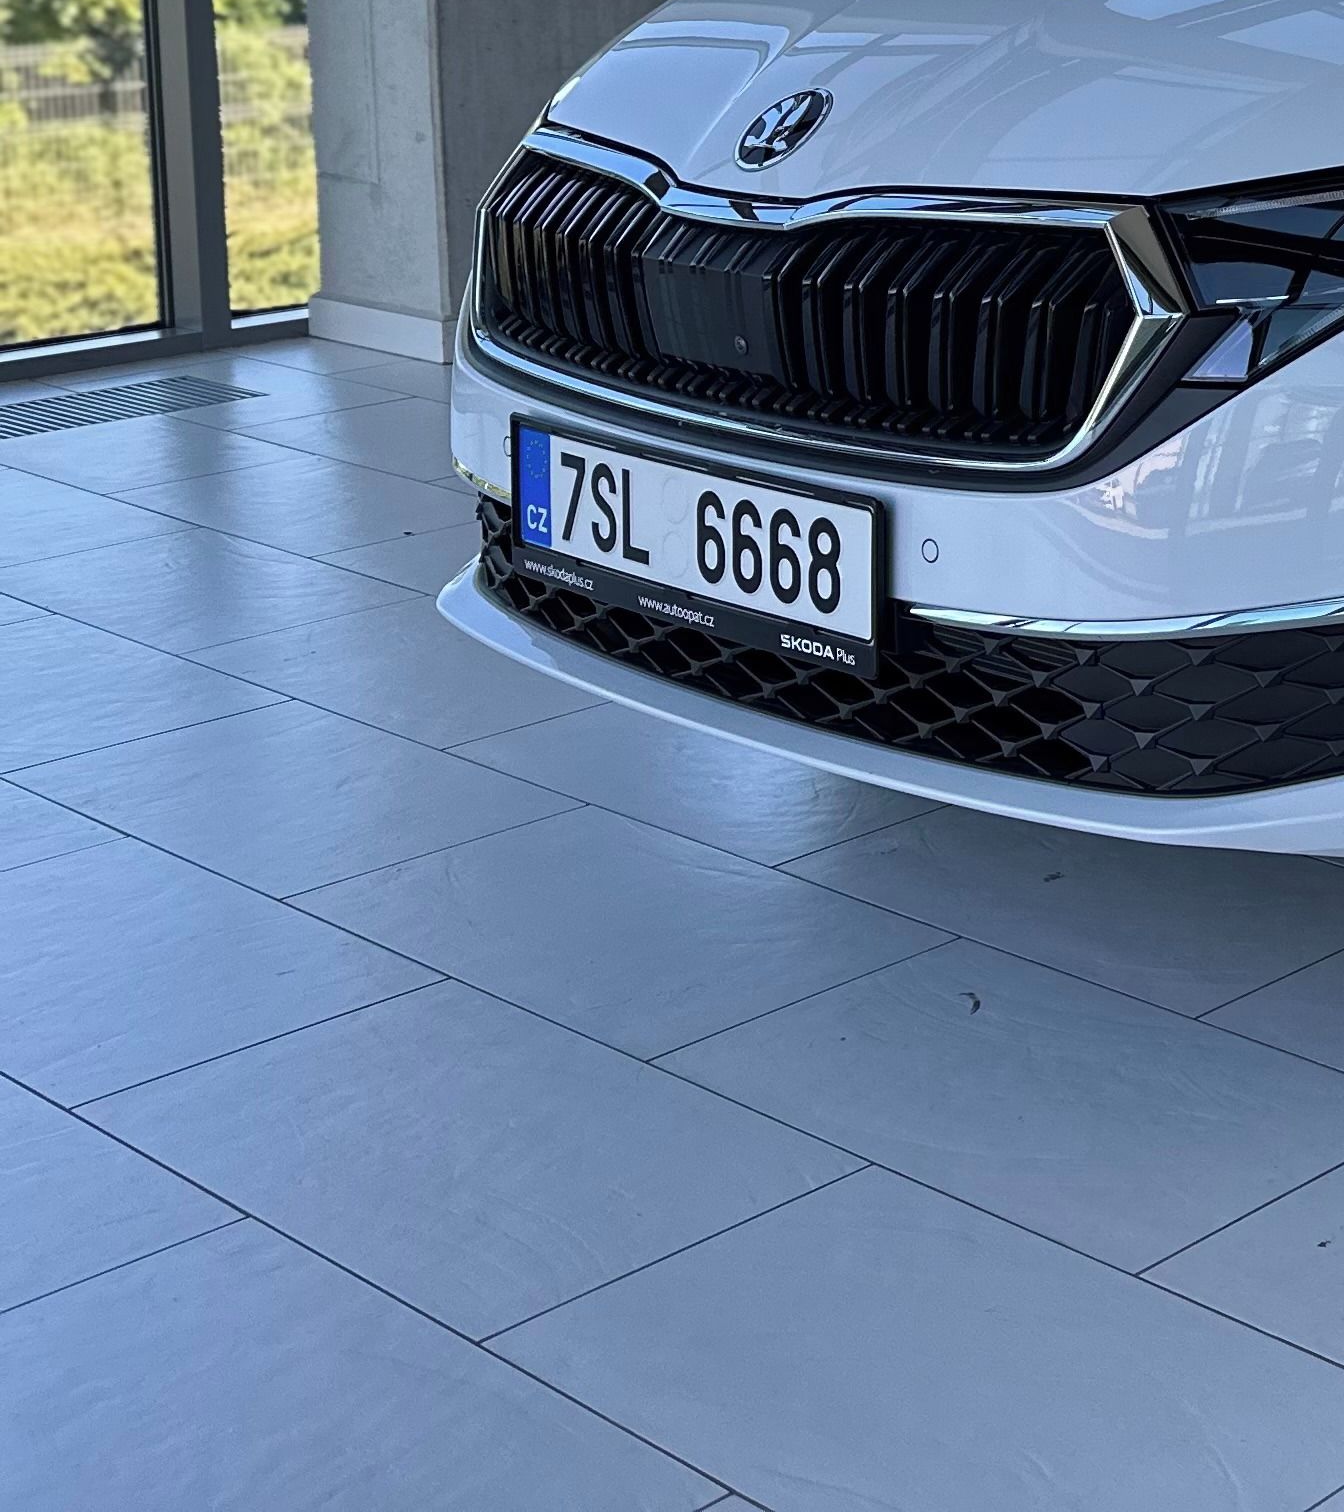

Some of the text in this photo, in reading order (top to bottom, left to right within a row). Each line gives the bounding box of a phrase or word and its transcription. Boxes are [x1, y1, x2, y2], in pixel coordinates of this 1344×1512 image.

[526, 504, 548, 534] CZ
[560, 451, 842, 614] 7SL 6668
[524, 559, 595, 591] www.skodaplus.cz
[638, 595, 715, 628] www.autoopat.cz
[836, 648, 856, 666] Plus
